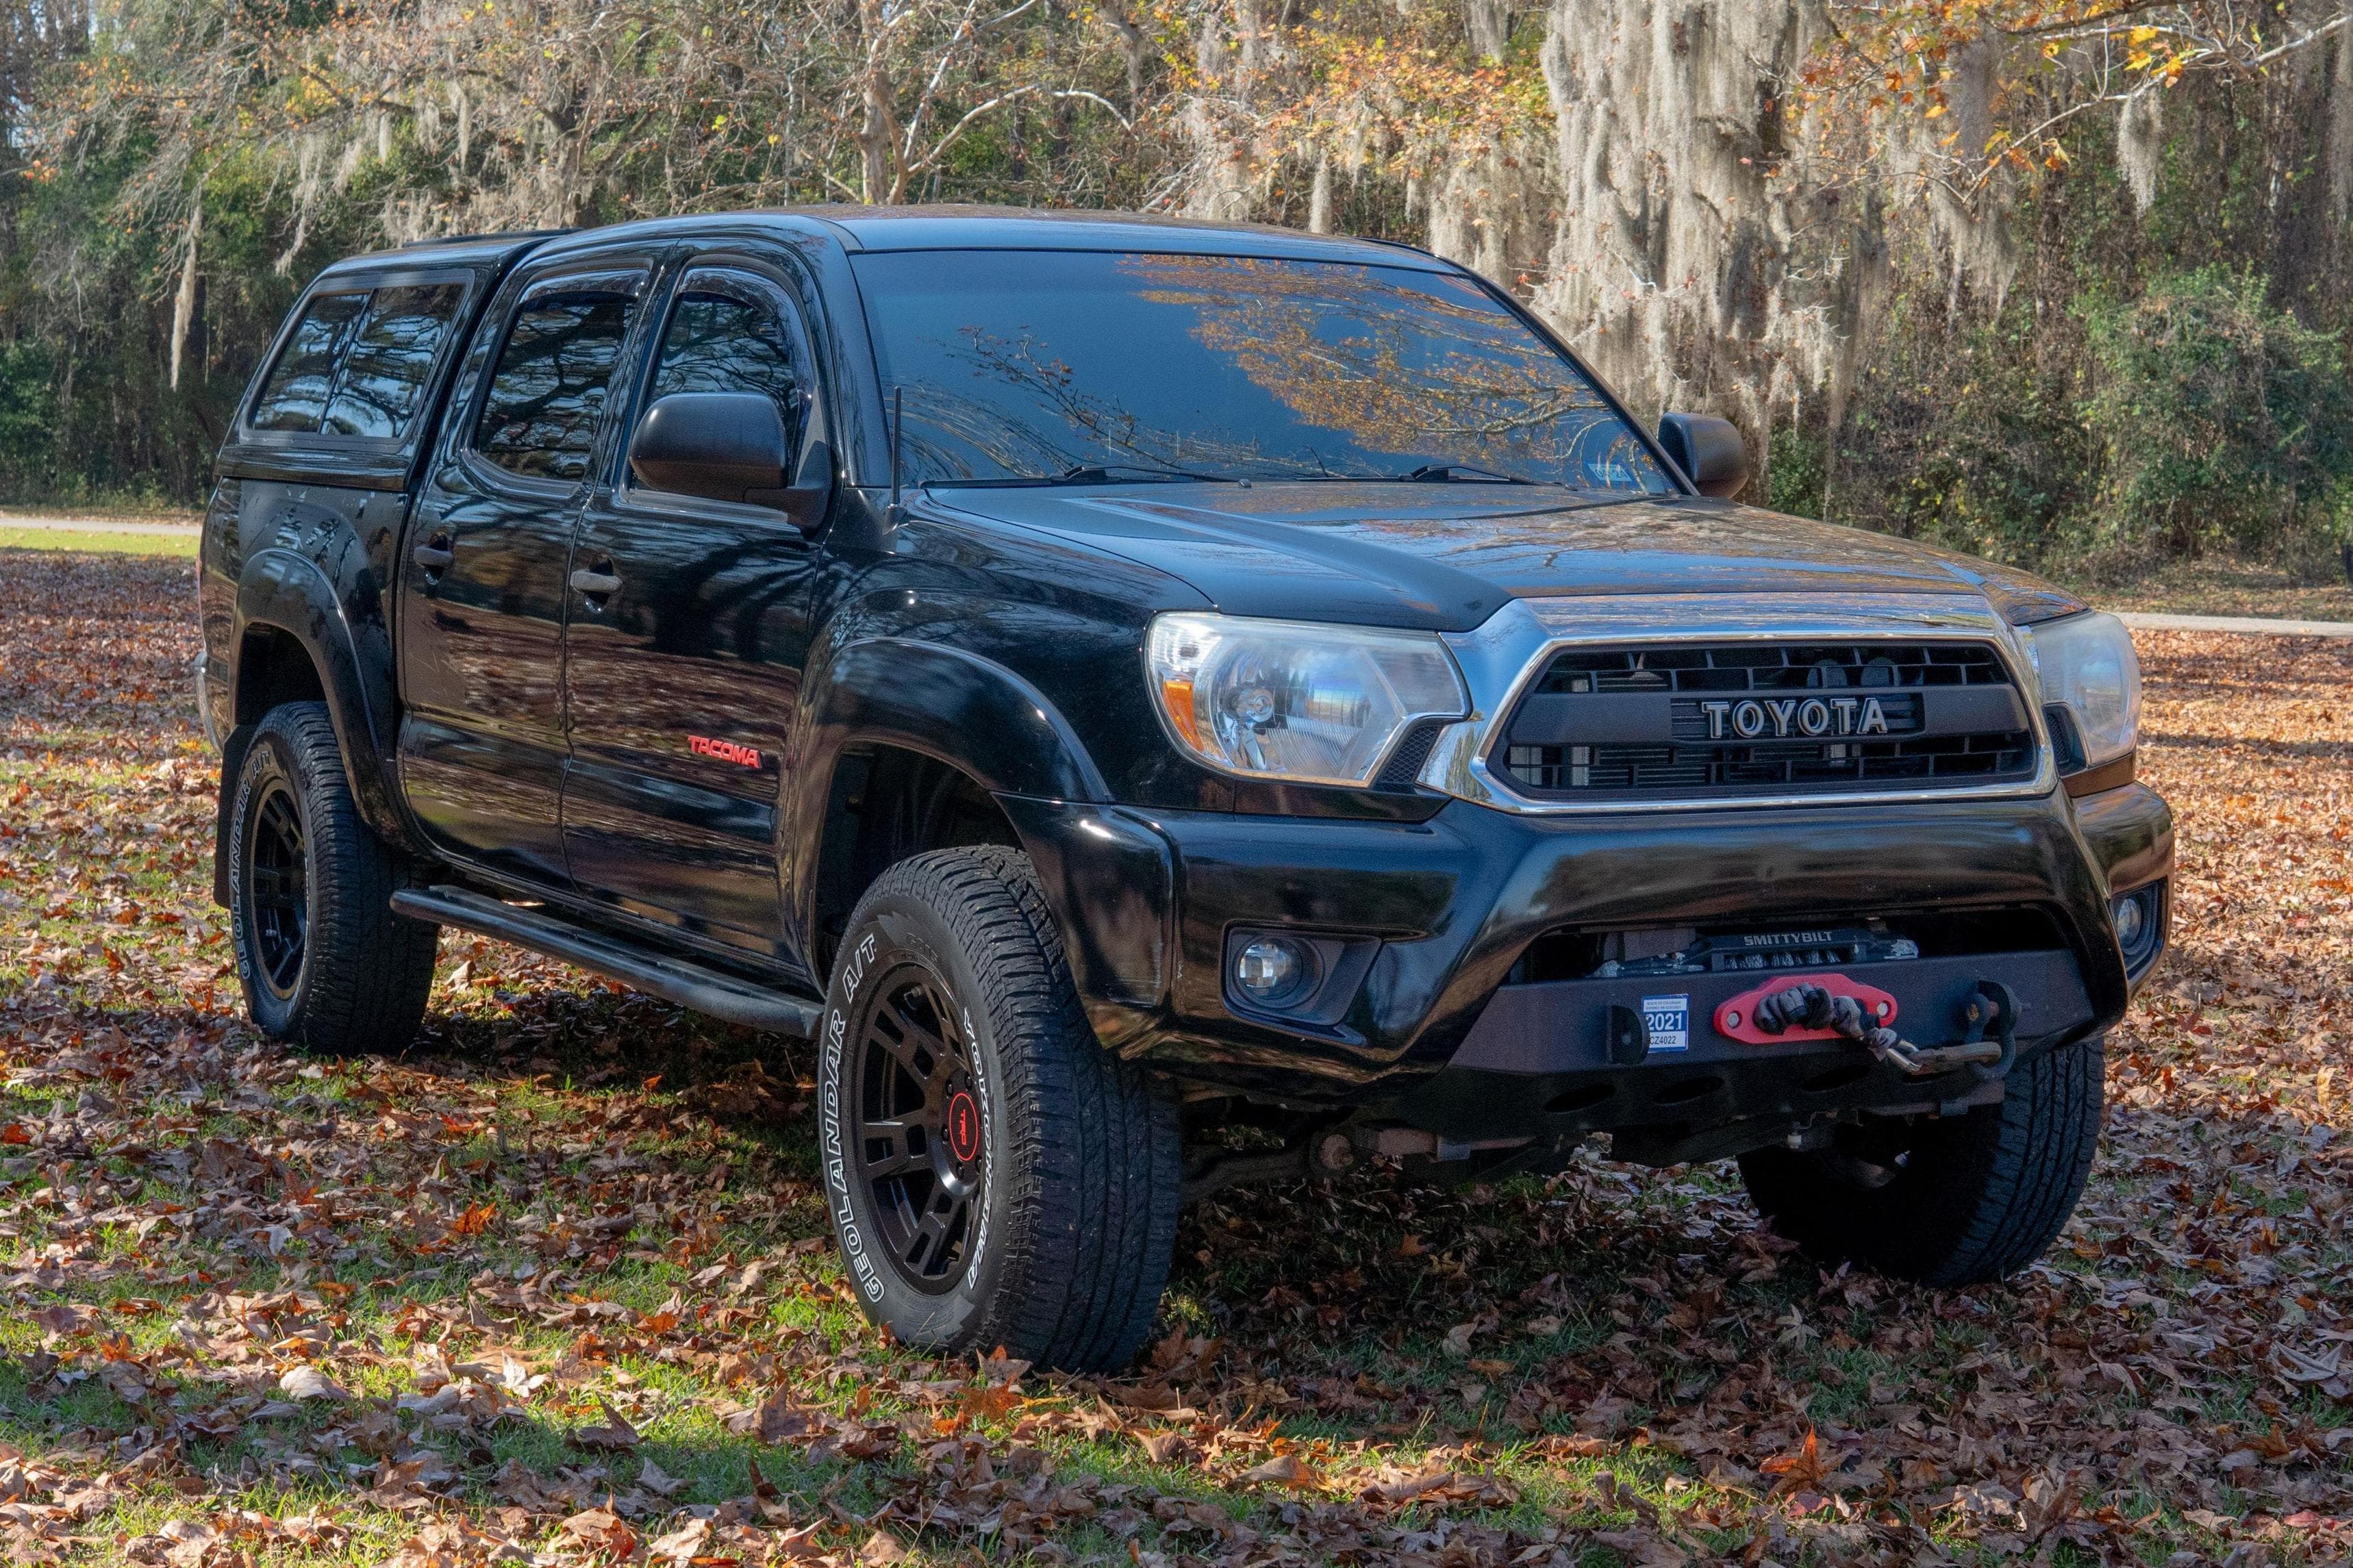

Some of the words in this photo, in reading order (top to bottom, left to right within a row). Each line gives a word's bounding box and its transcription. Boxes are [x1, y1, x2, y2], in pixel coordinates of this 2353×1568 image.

[1702, 697, 1888, 738] TOYOTA
[688, 735, 762, 769] TACOMA
[229, 778, 251, 981] GEOLANDAR
[251, 750, 269, 779] A/T
[1744, 931, 1832, 946] SMITTYBILT
[842, 933, 875, 1004] A/T
[1646, 1012, 1682, 1030] 2021
[824, 1009, 885, 1302] GEOLANDAR
[964, 1007, 993, 1290] YOKOHAMA
